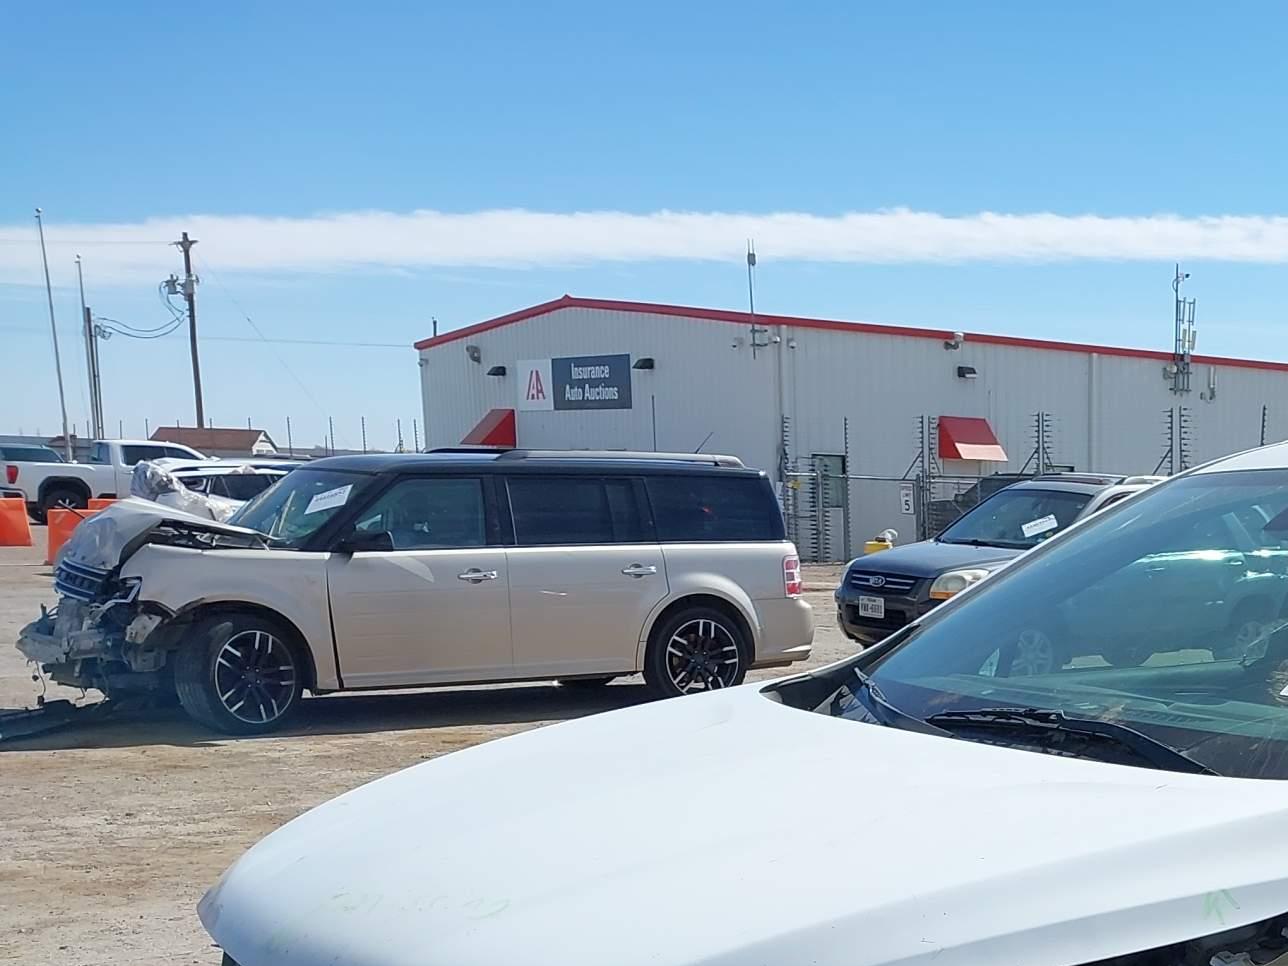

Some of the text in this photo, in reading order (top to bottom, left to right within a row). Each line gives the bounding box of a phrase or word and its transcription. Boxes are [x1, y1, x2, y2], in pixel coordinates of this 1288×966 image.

[571, 363, 610, 379] Insurance
[565, 383, 619, 401] Auto Auctions
[904, 499, 911, 512] 5
